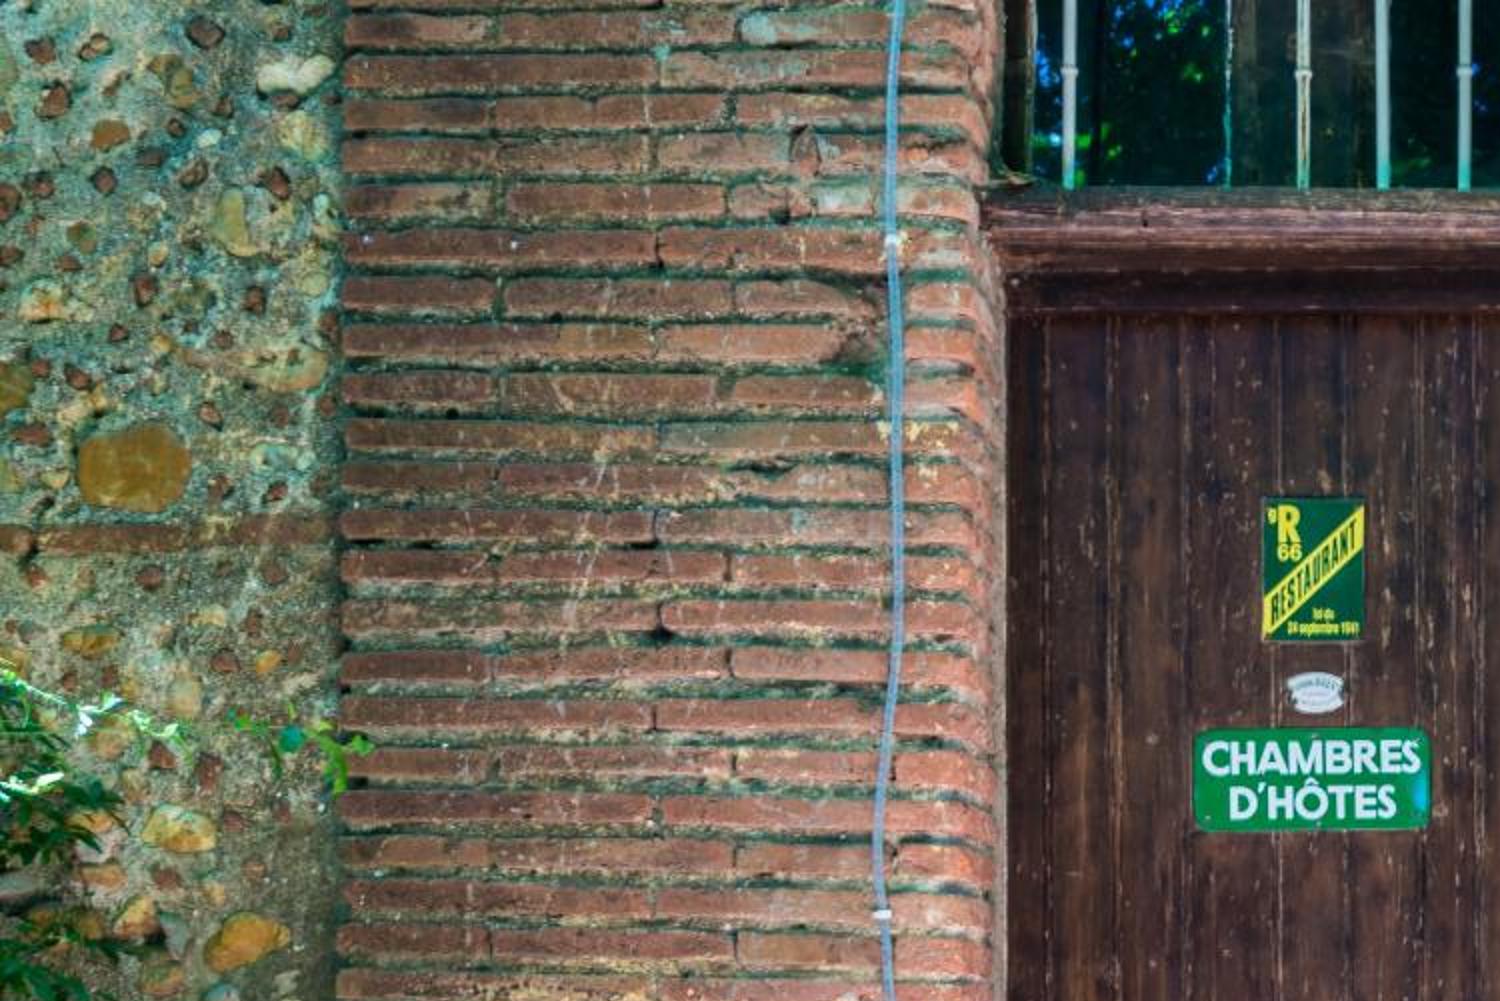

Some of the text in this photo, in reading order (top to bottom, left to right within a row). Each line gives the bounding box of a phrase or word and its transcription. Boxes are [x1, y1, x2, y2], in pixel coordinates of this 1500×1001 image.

[1270, 517, 1358, 627] RESTAURANT
[1277, 543, 1303, 563] 66
[1202, 739, 1422, 777] CHAMBRES
[1229, 777, 1398, 821] D'HÔTES
